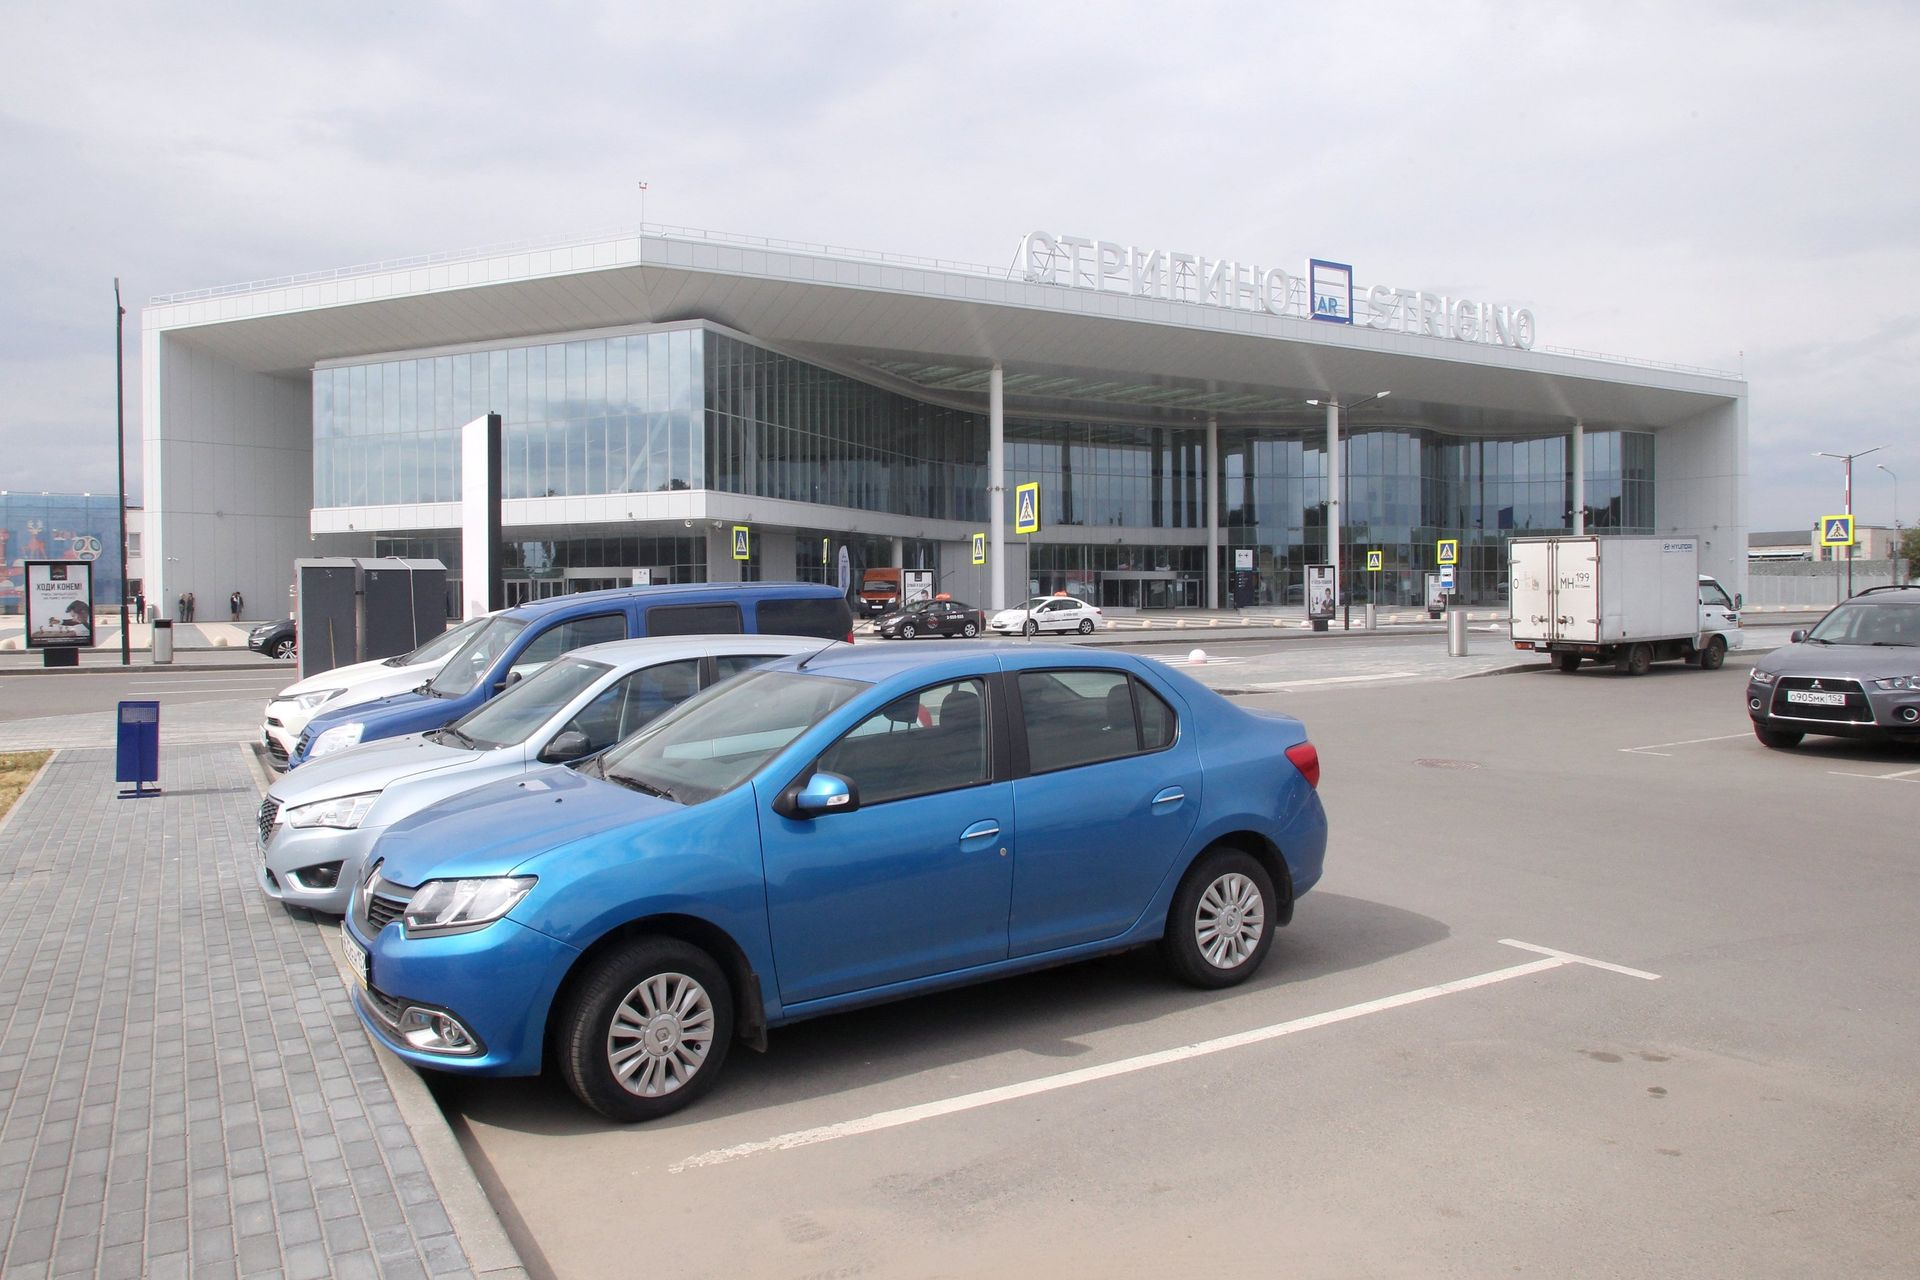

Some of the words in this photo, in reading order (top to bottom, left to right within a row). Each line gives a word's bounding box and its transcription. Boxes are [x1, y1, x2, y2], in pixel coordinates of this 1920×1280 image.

[1022, 230, 1291, 315] СТРИГИНО
[1366, 284, 1536, 350] STRIGINO
[1575, 572, 1590, 582] 199
[36, 582, 56, 592] ХОДИ
[56, 582, 83, 591] КОНЕМ!
[1827, 694, 1843, 702] 152
